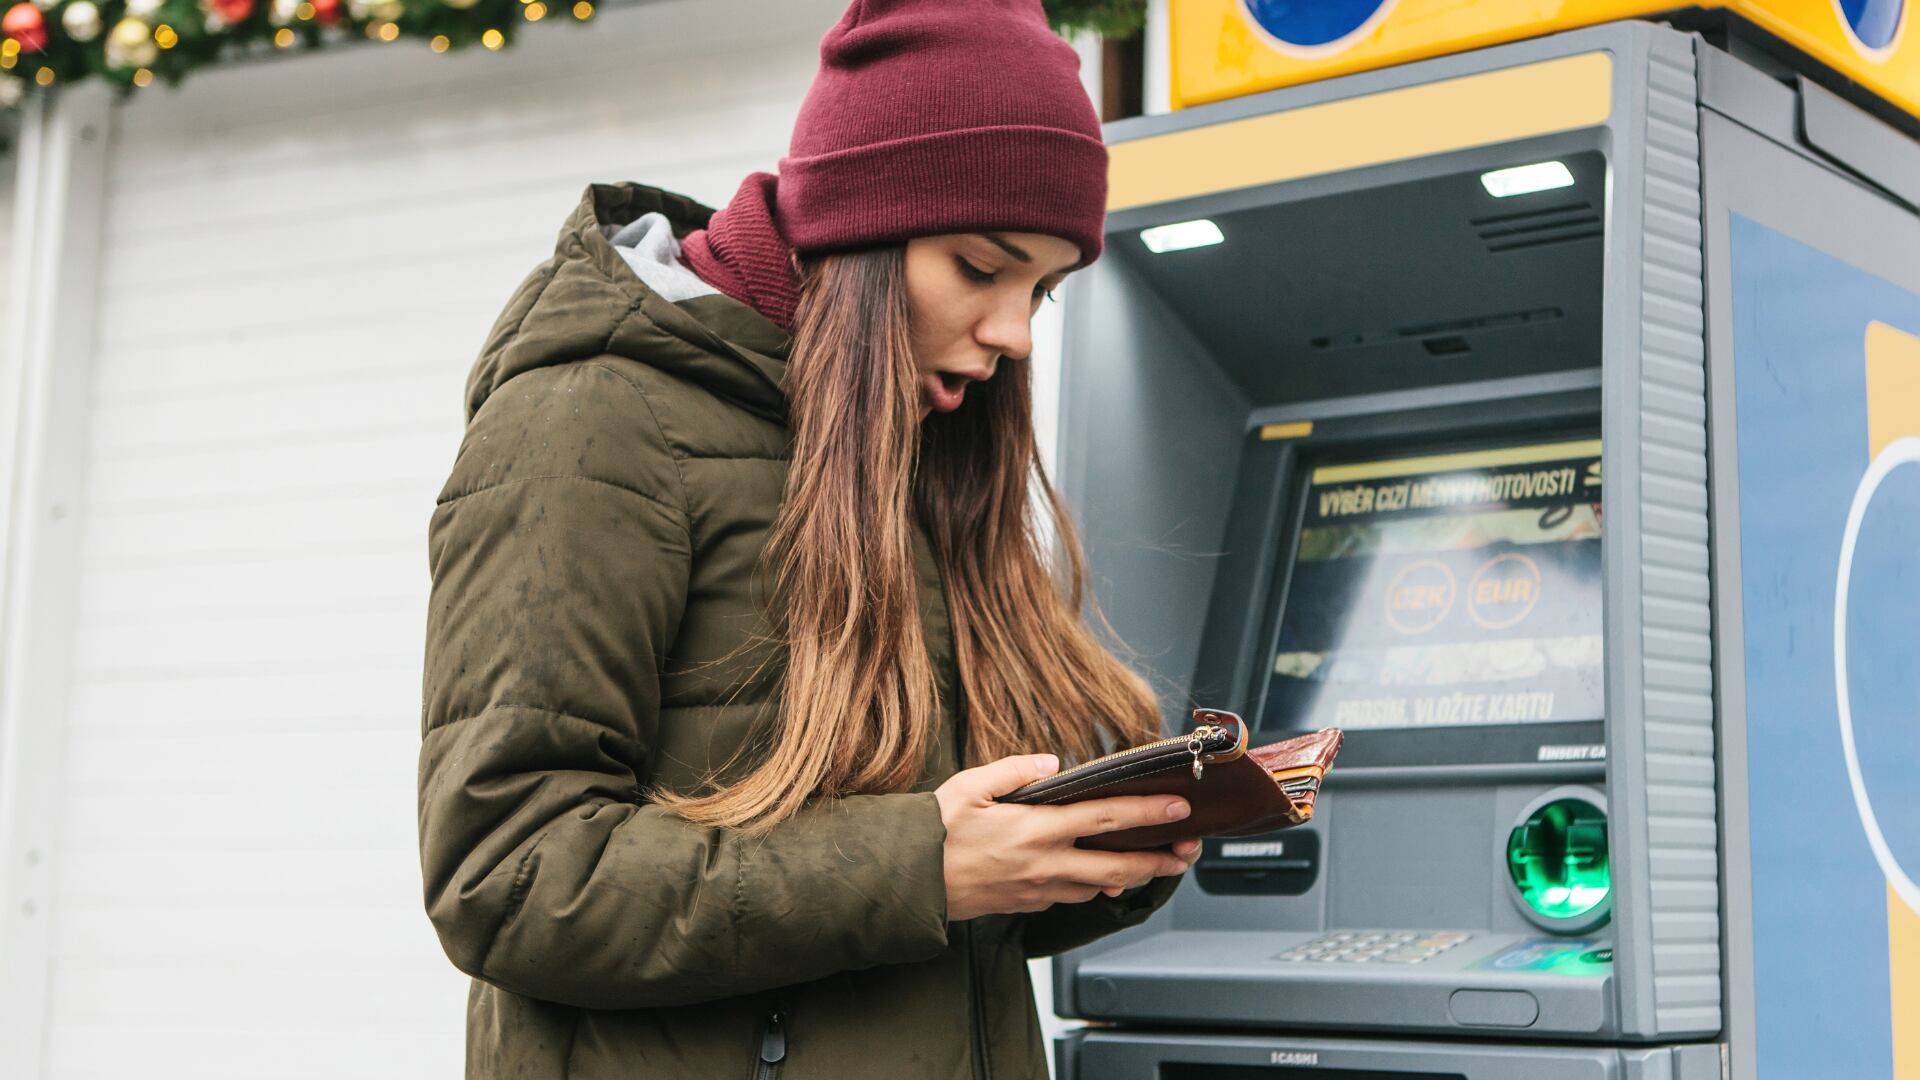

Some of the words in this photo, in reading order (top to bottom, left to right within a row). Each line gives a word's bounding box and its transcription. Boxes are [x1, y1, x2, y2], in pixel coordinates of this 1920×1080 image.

[1478, 468, 1576, 502] HOTOVOSTI
[1393, 585, 1447, 609] CZK
[1477, 579, 1533, 605] EUR
[1413, 691, 1484, 723] VLOŽTE
[1487, 691, 1555, 720] KARTU
